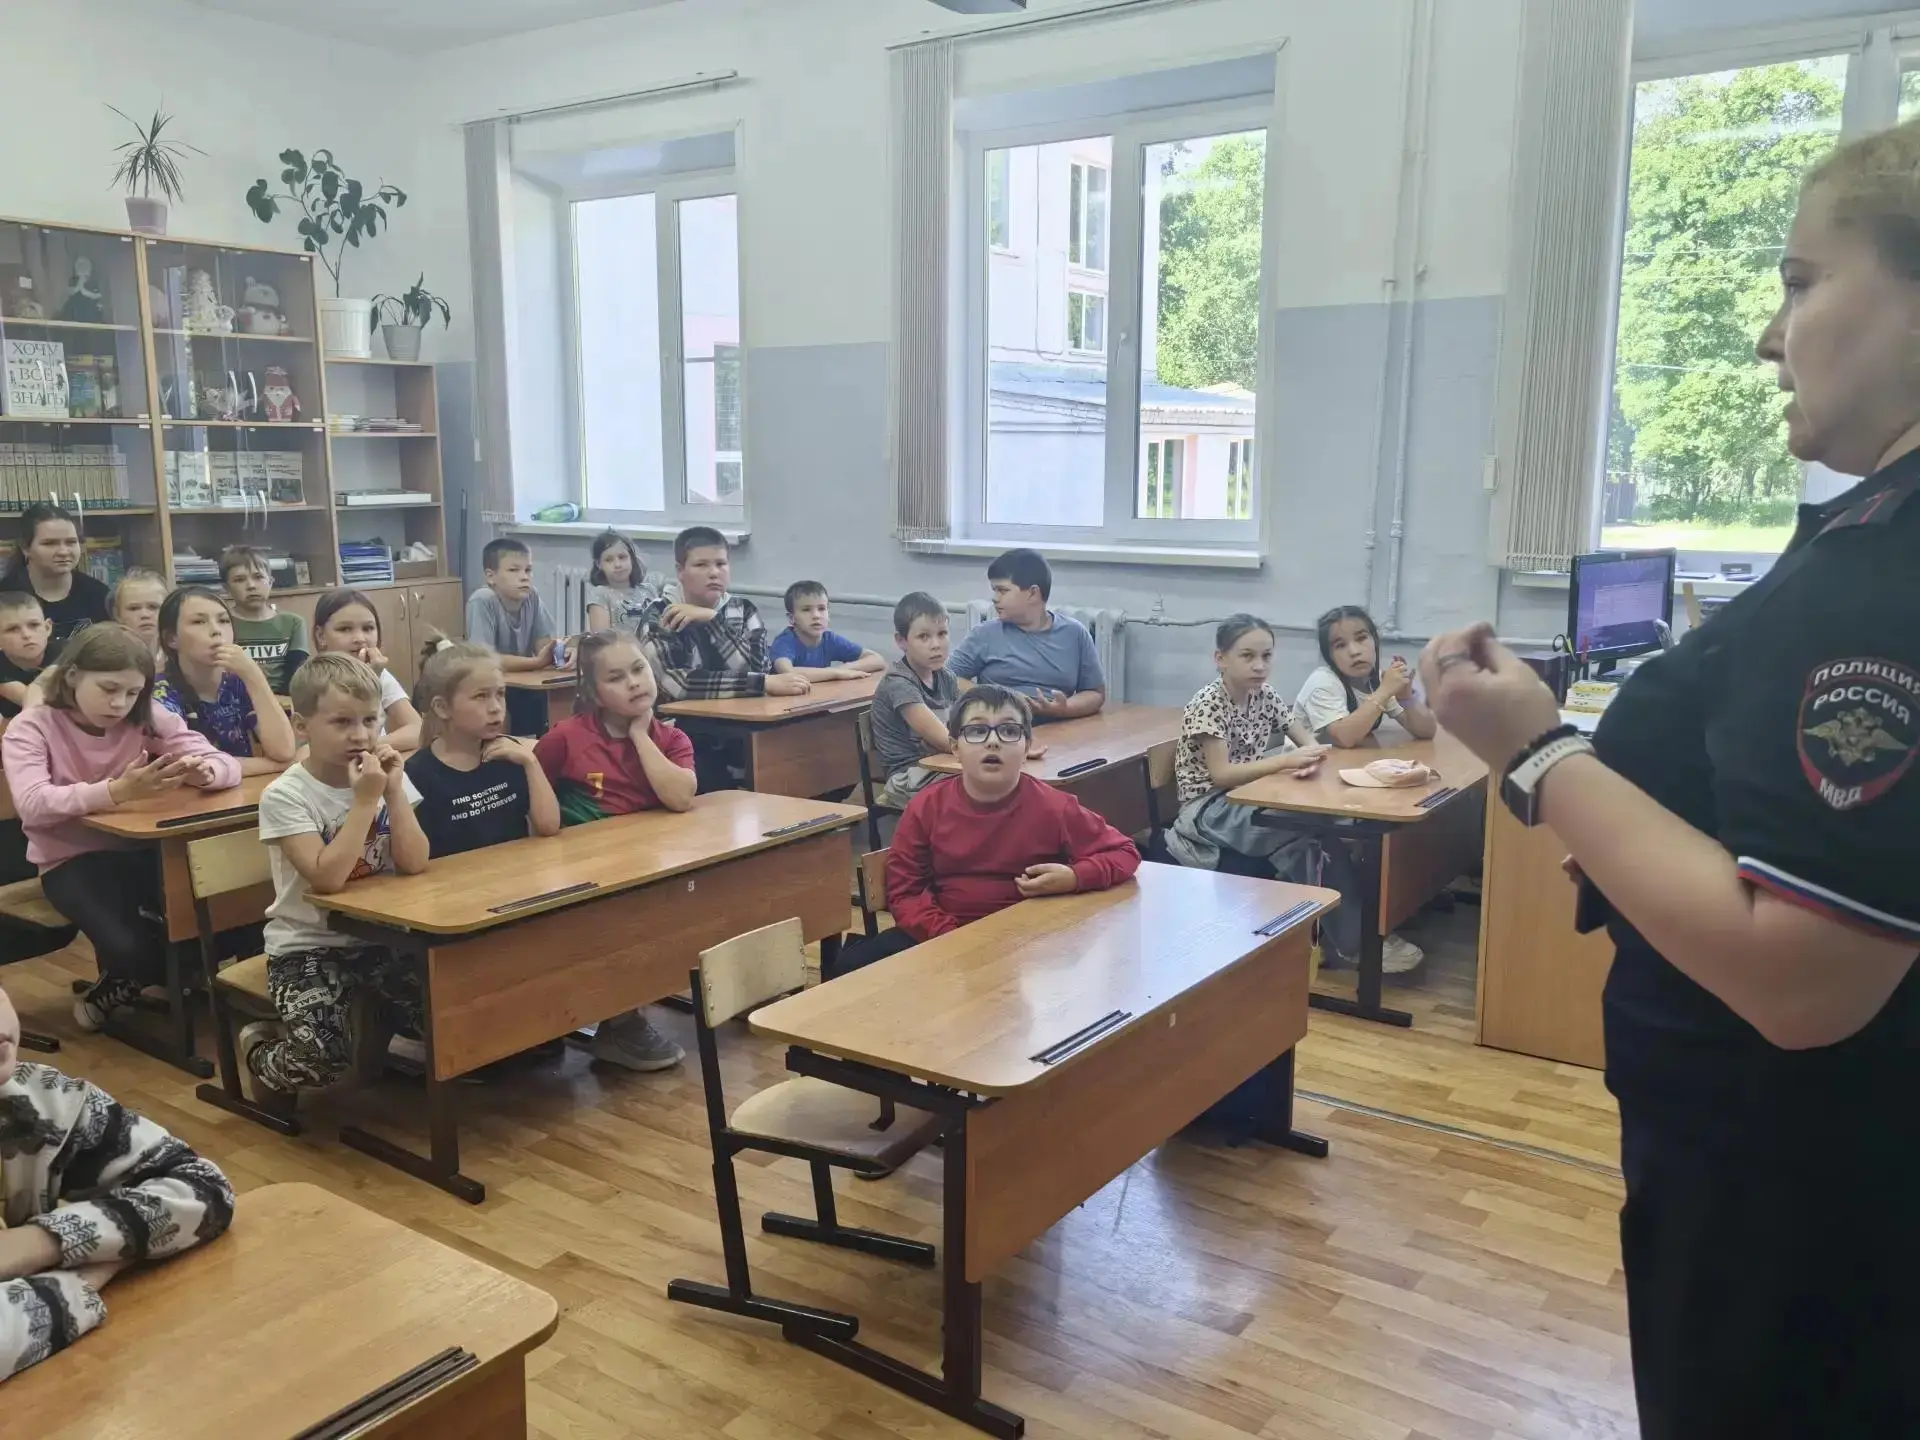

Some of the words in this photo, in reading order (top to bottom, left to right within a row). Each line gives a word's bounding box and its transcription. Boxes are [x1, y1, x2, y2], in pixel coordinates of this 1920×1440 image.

[12, 342, 58, 356] ХОЧУ
[19, 367, 54, 381] ВСЕ
[11, 391, 65, 406] ЗНАТЬ
[1813, 686, 1911, 725] РОССИЯ
[483, 794, 500, 804] LIKE
[1819, 777, 1863, 808] МВД
[452, 795, 471, 806] FIND
[451, 812, 468, 821] AND
[469, 808, 480, 817] DO
